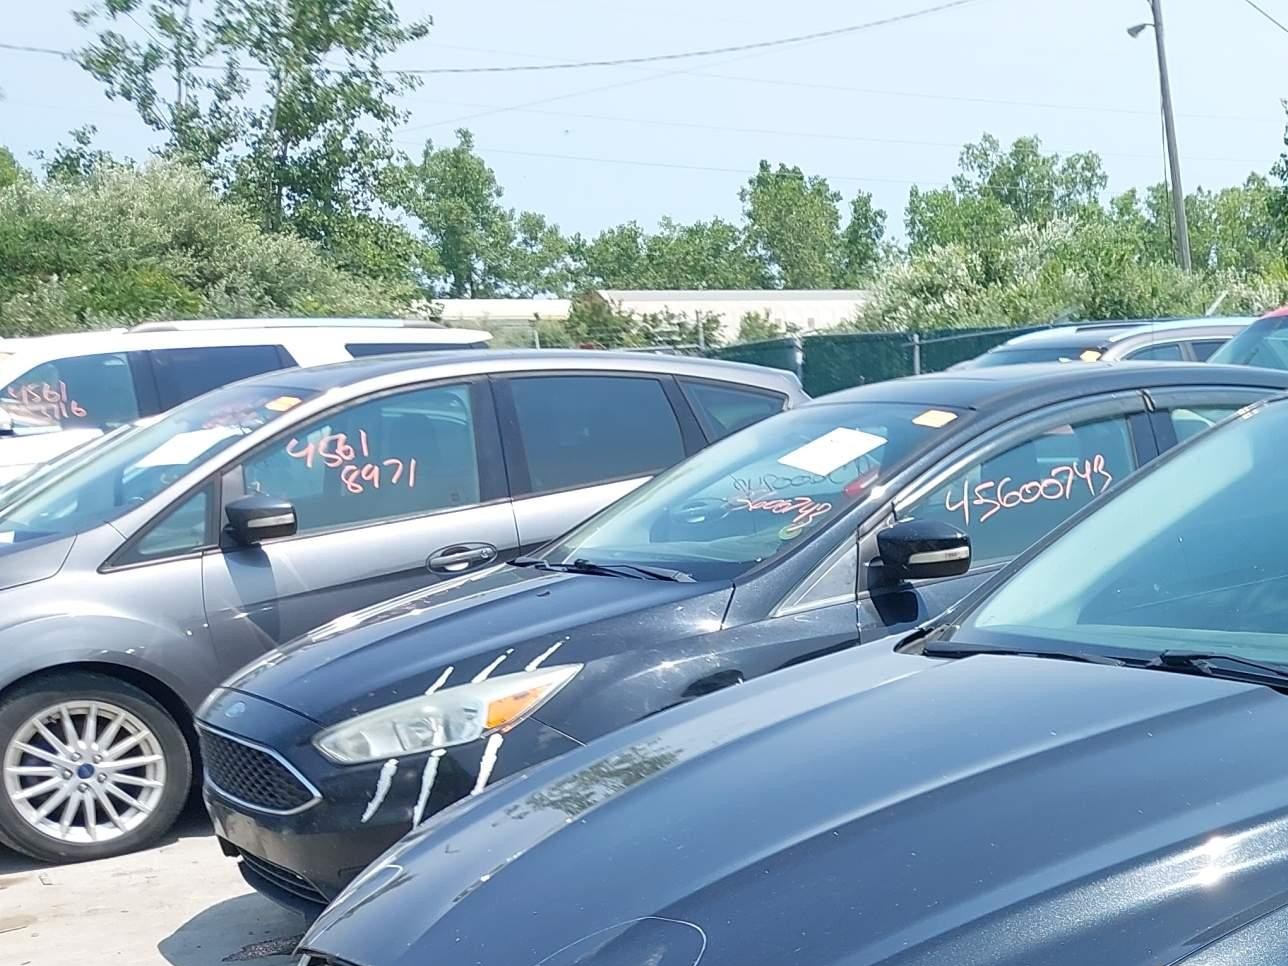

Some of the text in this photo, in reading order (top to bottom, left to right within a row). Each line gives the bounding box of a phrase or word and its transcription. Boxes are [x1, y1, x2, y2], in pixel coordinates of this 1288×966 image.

[286, 429, 369, 469] 4561
[341, 458, 417, 494] 8971
[945, 454, 1113, 527] 45600743
